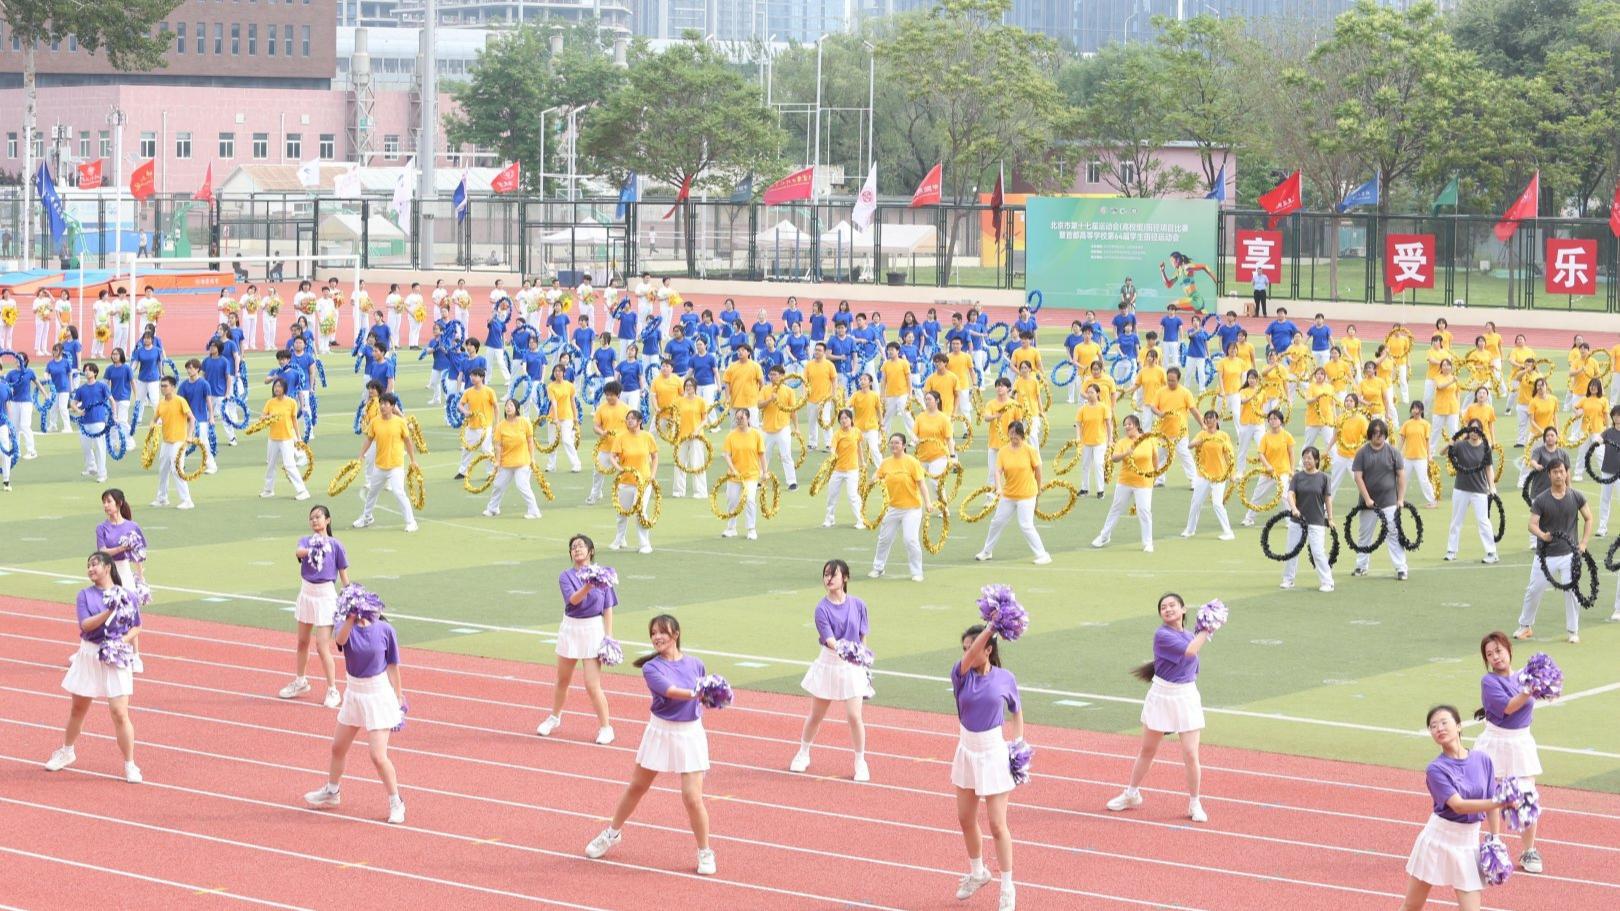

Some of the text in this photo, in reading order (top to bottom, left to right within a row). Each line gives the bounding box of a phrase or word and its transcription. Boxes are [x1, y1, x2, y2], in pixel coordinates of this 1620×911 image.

[1242, 237, 1275, 273] 享
[1393, 241, 1427, 282] 受
[1553, 246, 1589, 288] 乐
